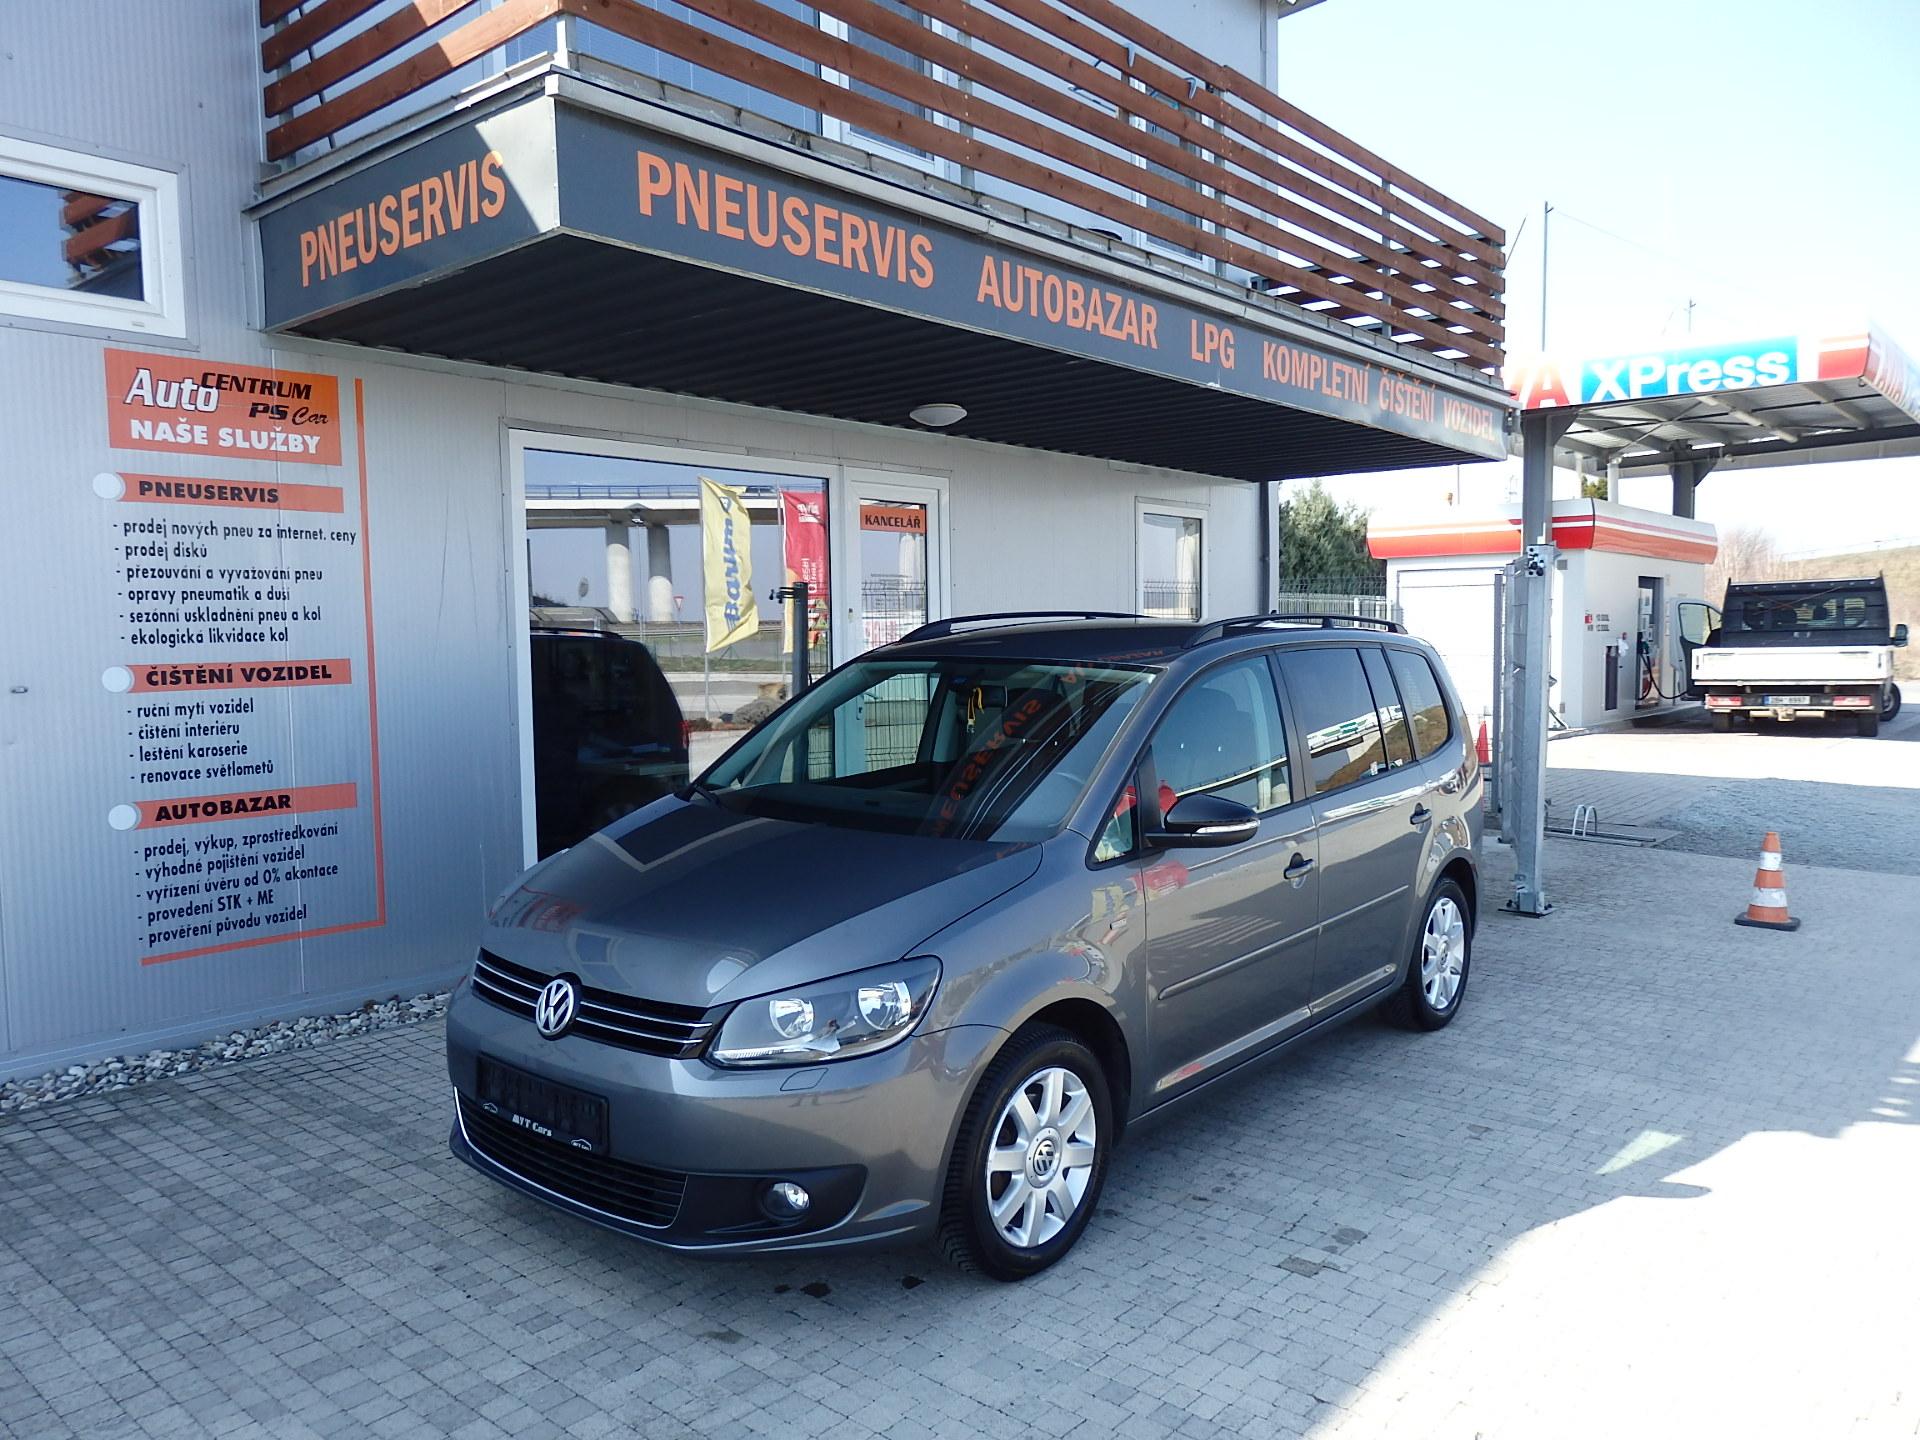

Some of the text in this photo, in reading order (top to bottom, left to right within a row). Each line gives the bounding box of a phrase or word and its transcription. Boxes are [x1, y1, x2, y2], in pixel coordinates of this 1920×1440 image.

[300, 150, 506, 288] PNEUSERVIS
[637, 151, 1495, 441] PNEUSERVIS AUTOBAZAR LPG KOMPLETNÍ ČIŠTĚNÍ VOZIDEL
[123, 367, 312, 413] Auto CENTRUM
[249, 402, 329, 426] PS Car
[130, 417, 321, 454] NAŠE SLUŽBY
[139, 480, 279, 504] PNEUSERVIS
[123, 518, 356, 545] prodej nových pneu za internet. ceny
[864, 514, 921, 529] KANCELÁŘ
[125, 540, 207, 561] prodej disků
[127, 564, 322, 584] přezouvání a vyvažování pneu
[128, 590, 175, 604] opravy
[181, 585, 249, 604] pneumatik
[255, 590, 262, 600] a
[130, 605, 321, 625] sezónní uskladnění pneu a kol
[131, 626, 288, 648] ekologická likvidace kol
[146, 663, 332, 686] ČIŠTĚNÍ VOZIDEL
[137, 702, 169, 718] ruční
[209, 697, 254, 714] vozidel
[138, 720, 240, 739] čištění interiéru
[139, 740, 247, 761] leštění karoserie
[140, 760, 273, 783] renovace světlometů
[155, 794, 291, 821] AUTOBAZAR
[144, 822, 338, 862] prodej, výkup, zprostředkování
[145, 844, 304, 882] výhodné pojištění vozidel
[146, 865, 338, 904] vyřízení úvěru od 0% akontace
[148, 899, 213, 927] provedení
[217, 894, 242, 911] STK
[257, 889, 273, 905] ME
[149, 904, 306, 948] prověření původu vozidel
[532, 1122, 553, 1137] Cars
